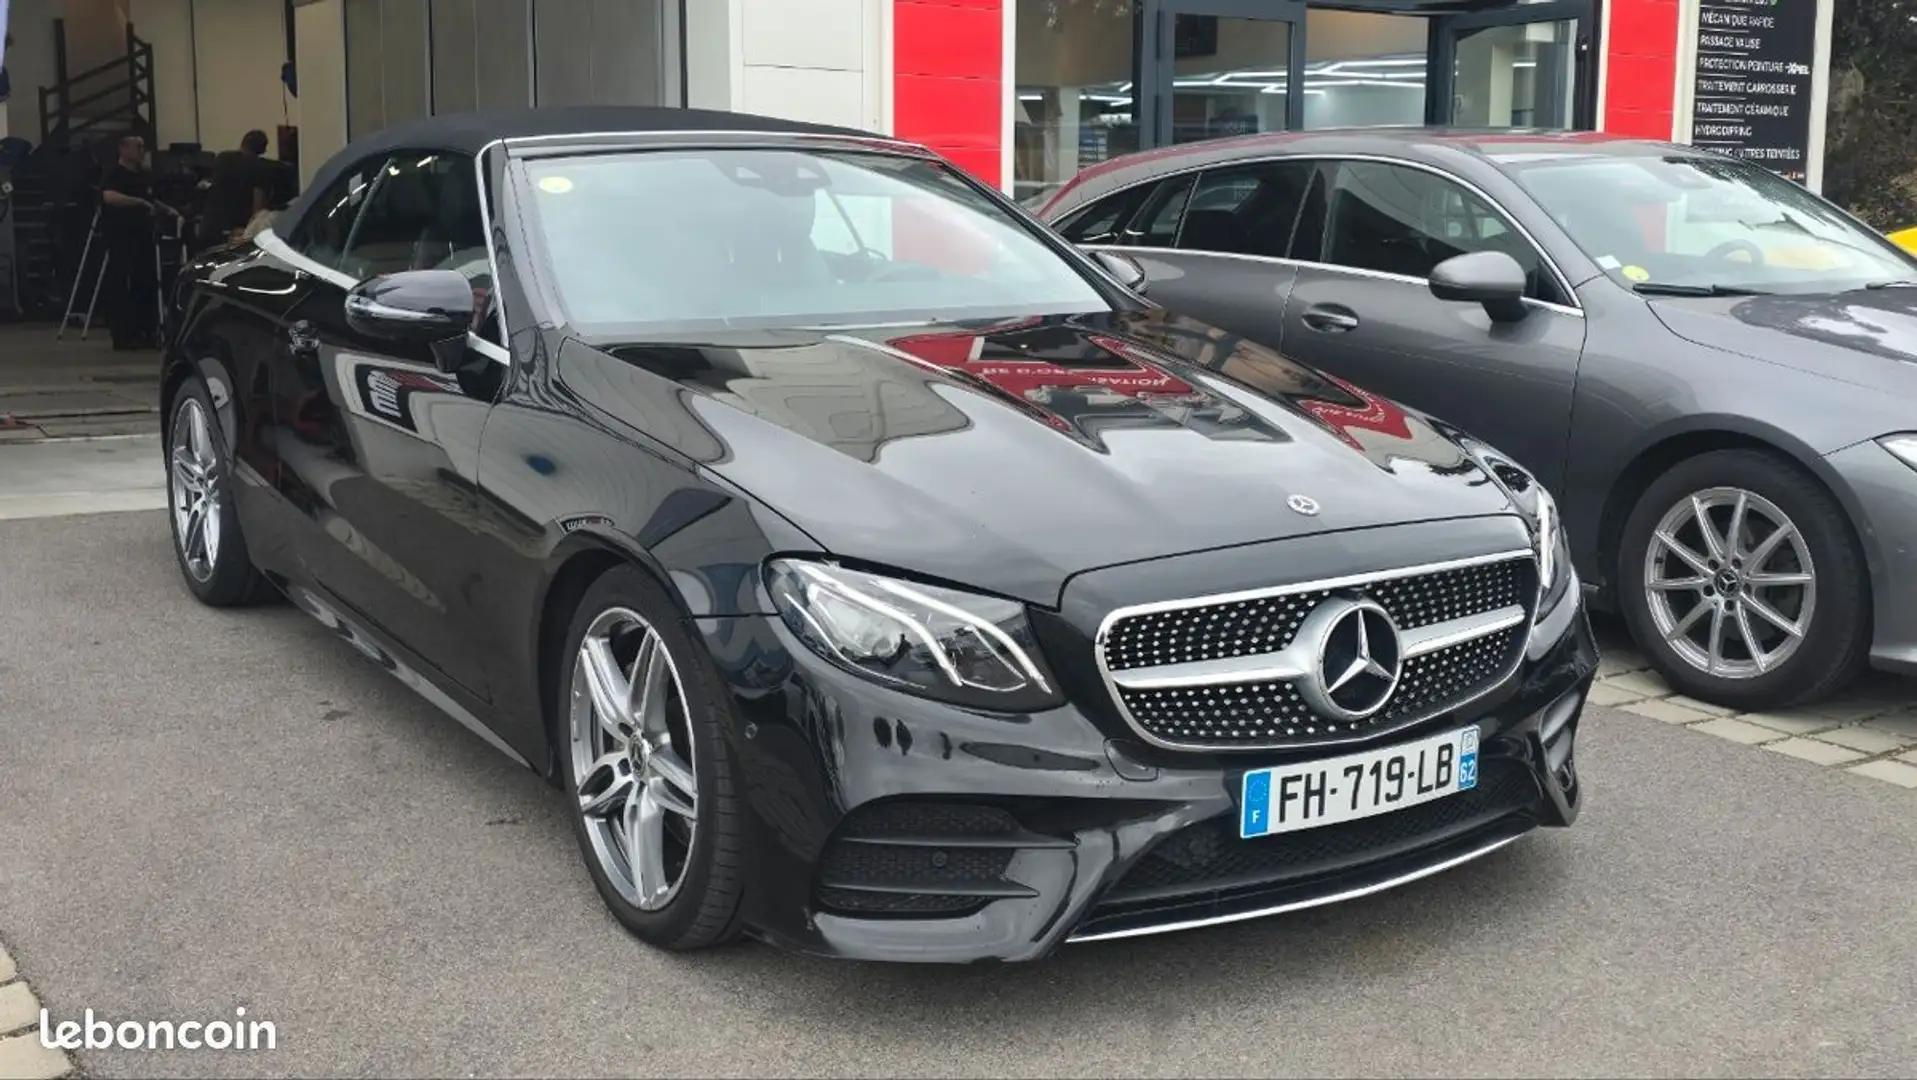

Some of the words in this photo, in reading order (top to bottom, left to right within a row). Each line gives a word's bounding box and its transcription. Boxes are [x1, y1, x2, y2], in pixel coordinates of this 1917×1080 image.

[1701, 12, 1748, 27] MÉCANIQUE
[1700, 34, 1734, 48] PASSAGE
[1735, 37, 1761, 49] VALISE
[1700, 57, 1747, 70] PROTECTION
[1748, 60, 1784, 72] PEINTURE
[1698, 79, 1745, 92] TRAITEMENT
[1746, 82, 1797, 95] CARROSSERIE
[1697, 102, 1744, 114] TRAITEMENT
[1745, 102, 1789, 116] CÉRAMIQUE
[1460, 760, 1476, 783] 62
[1278, 743, 1454, 823] FH-719-LB
[1252, 810, 1260, 824] F
